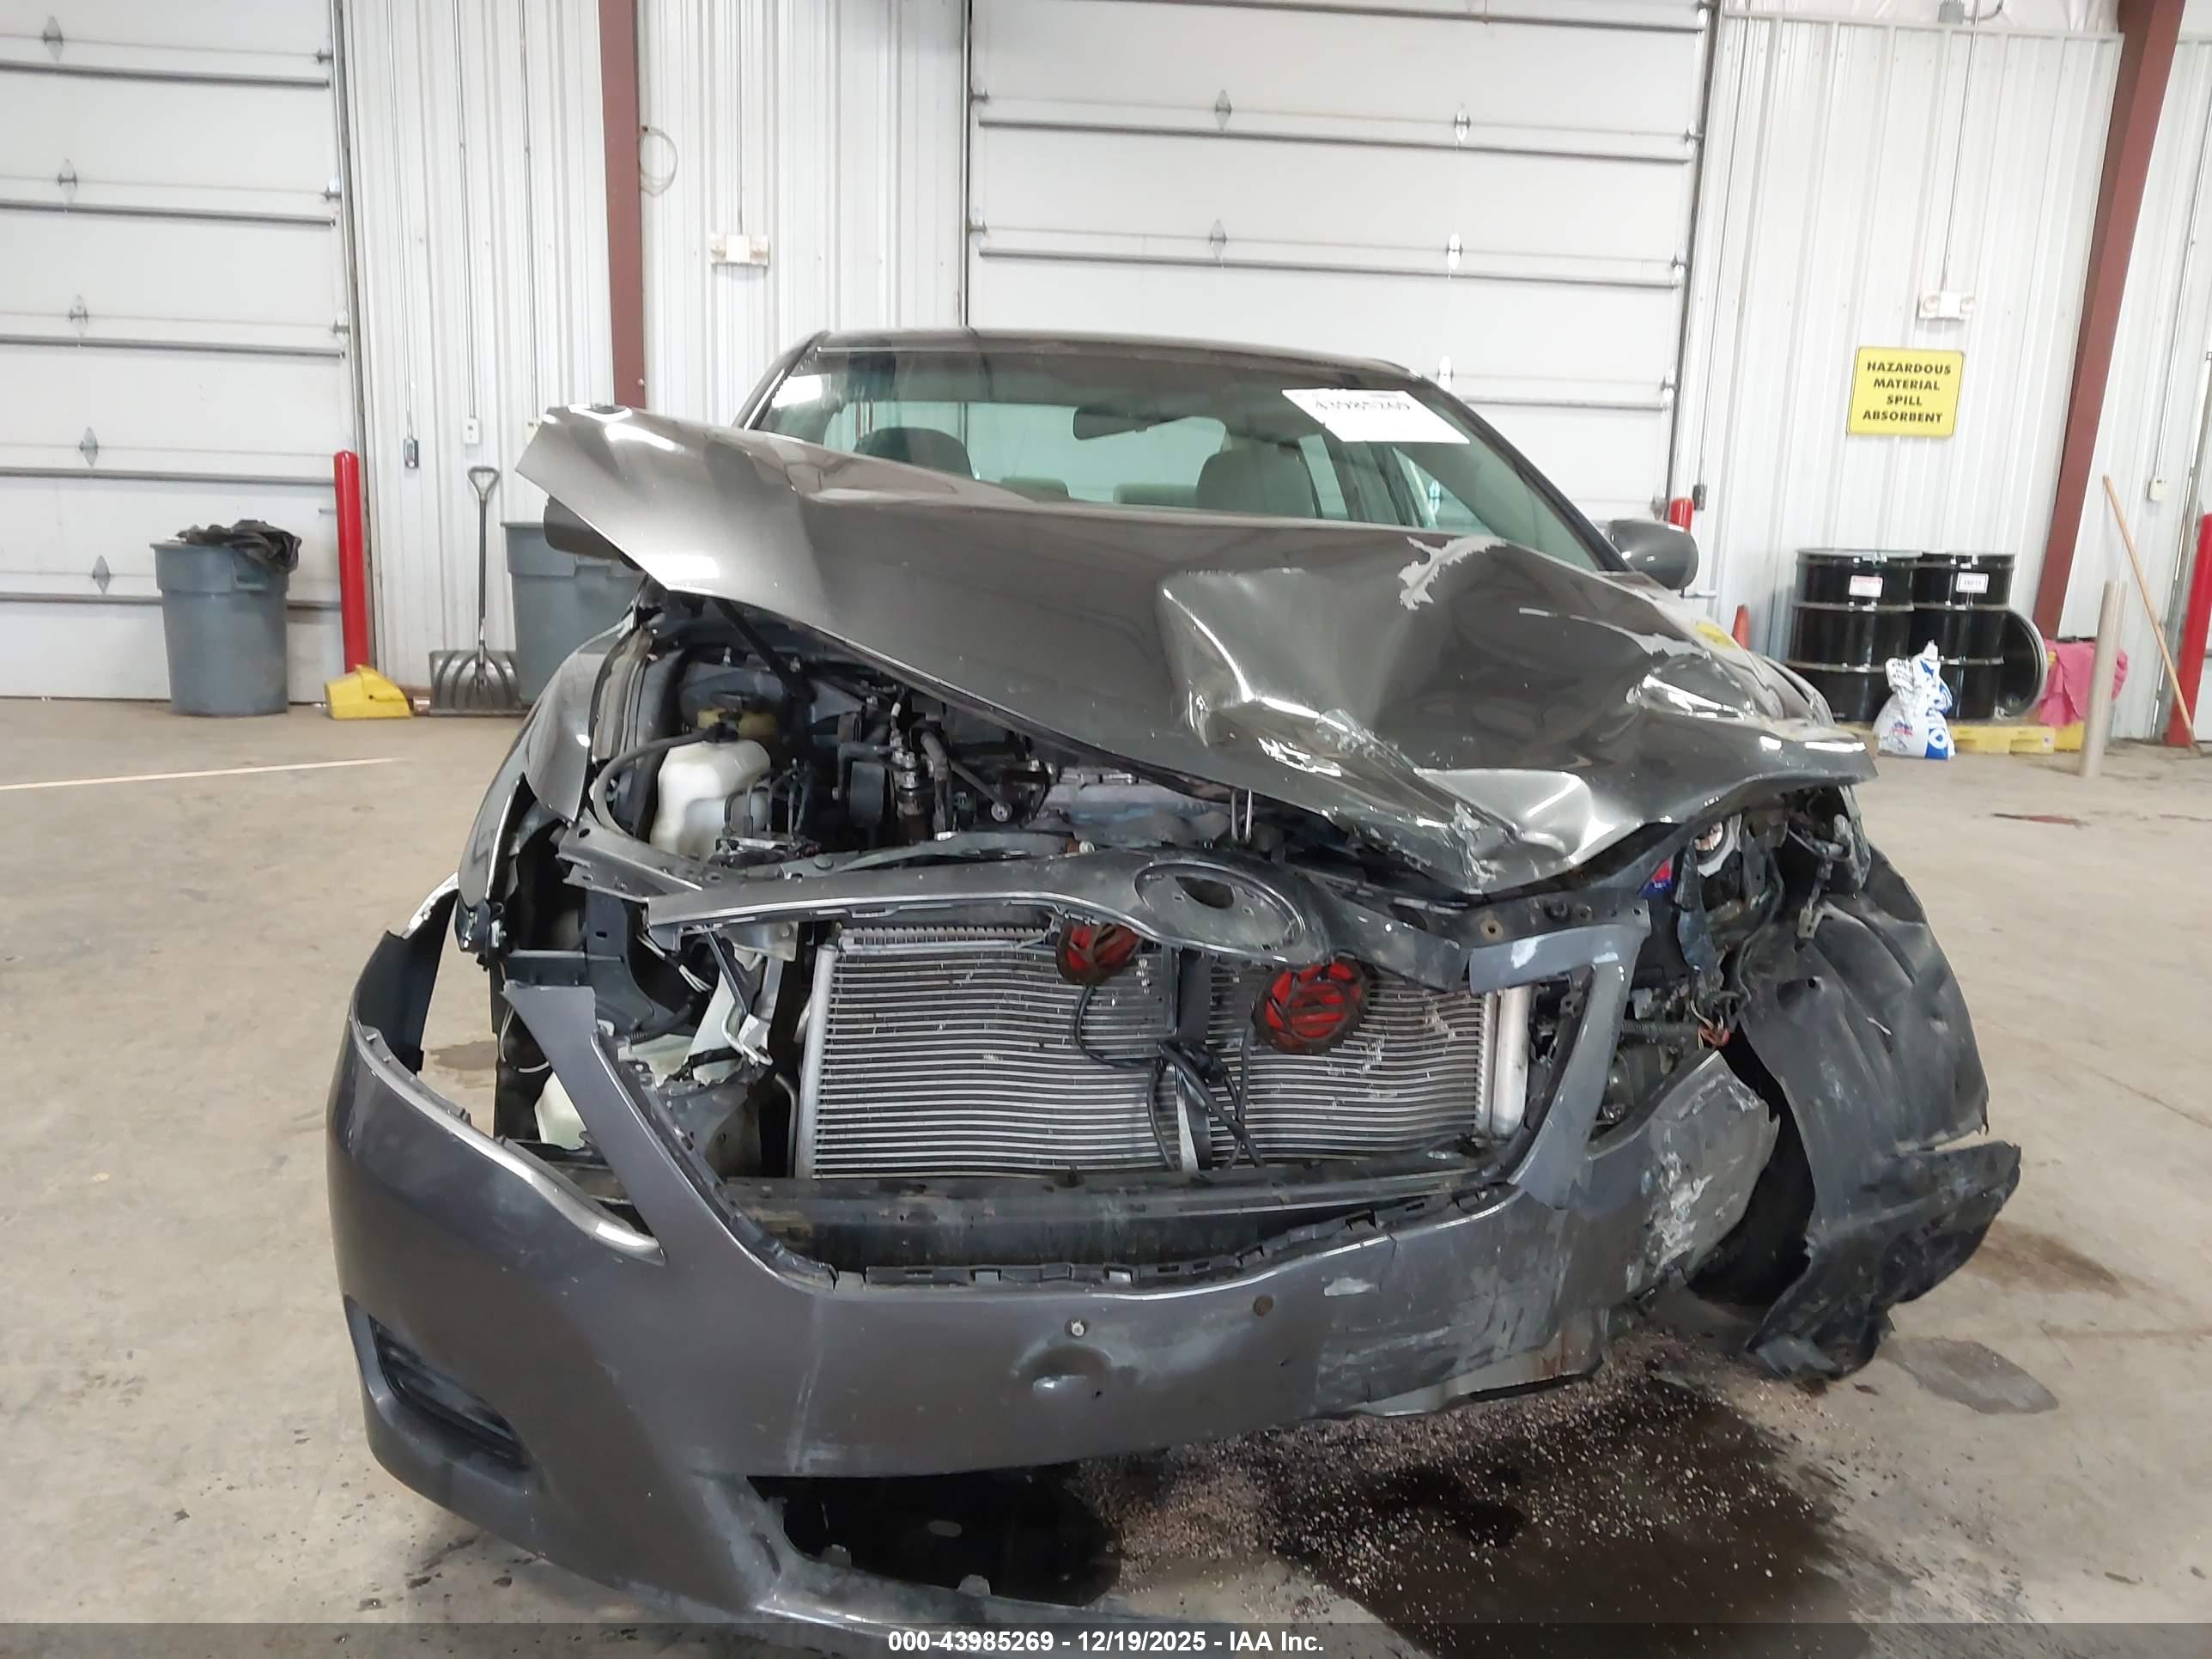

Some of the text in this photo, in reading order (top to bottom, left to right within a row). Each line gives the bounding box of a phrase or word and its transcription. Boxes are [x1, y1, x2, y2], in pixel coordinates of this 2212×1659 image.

[1866, 361, 1952, 375] HAZARDOUS
[1873, 378, 1941, 391] MATERIAL
[1886, 394, 1923, 406] SPILL
[1862, 410, 1943, 423] ABSORBENT
